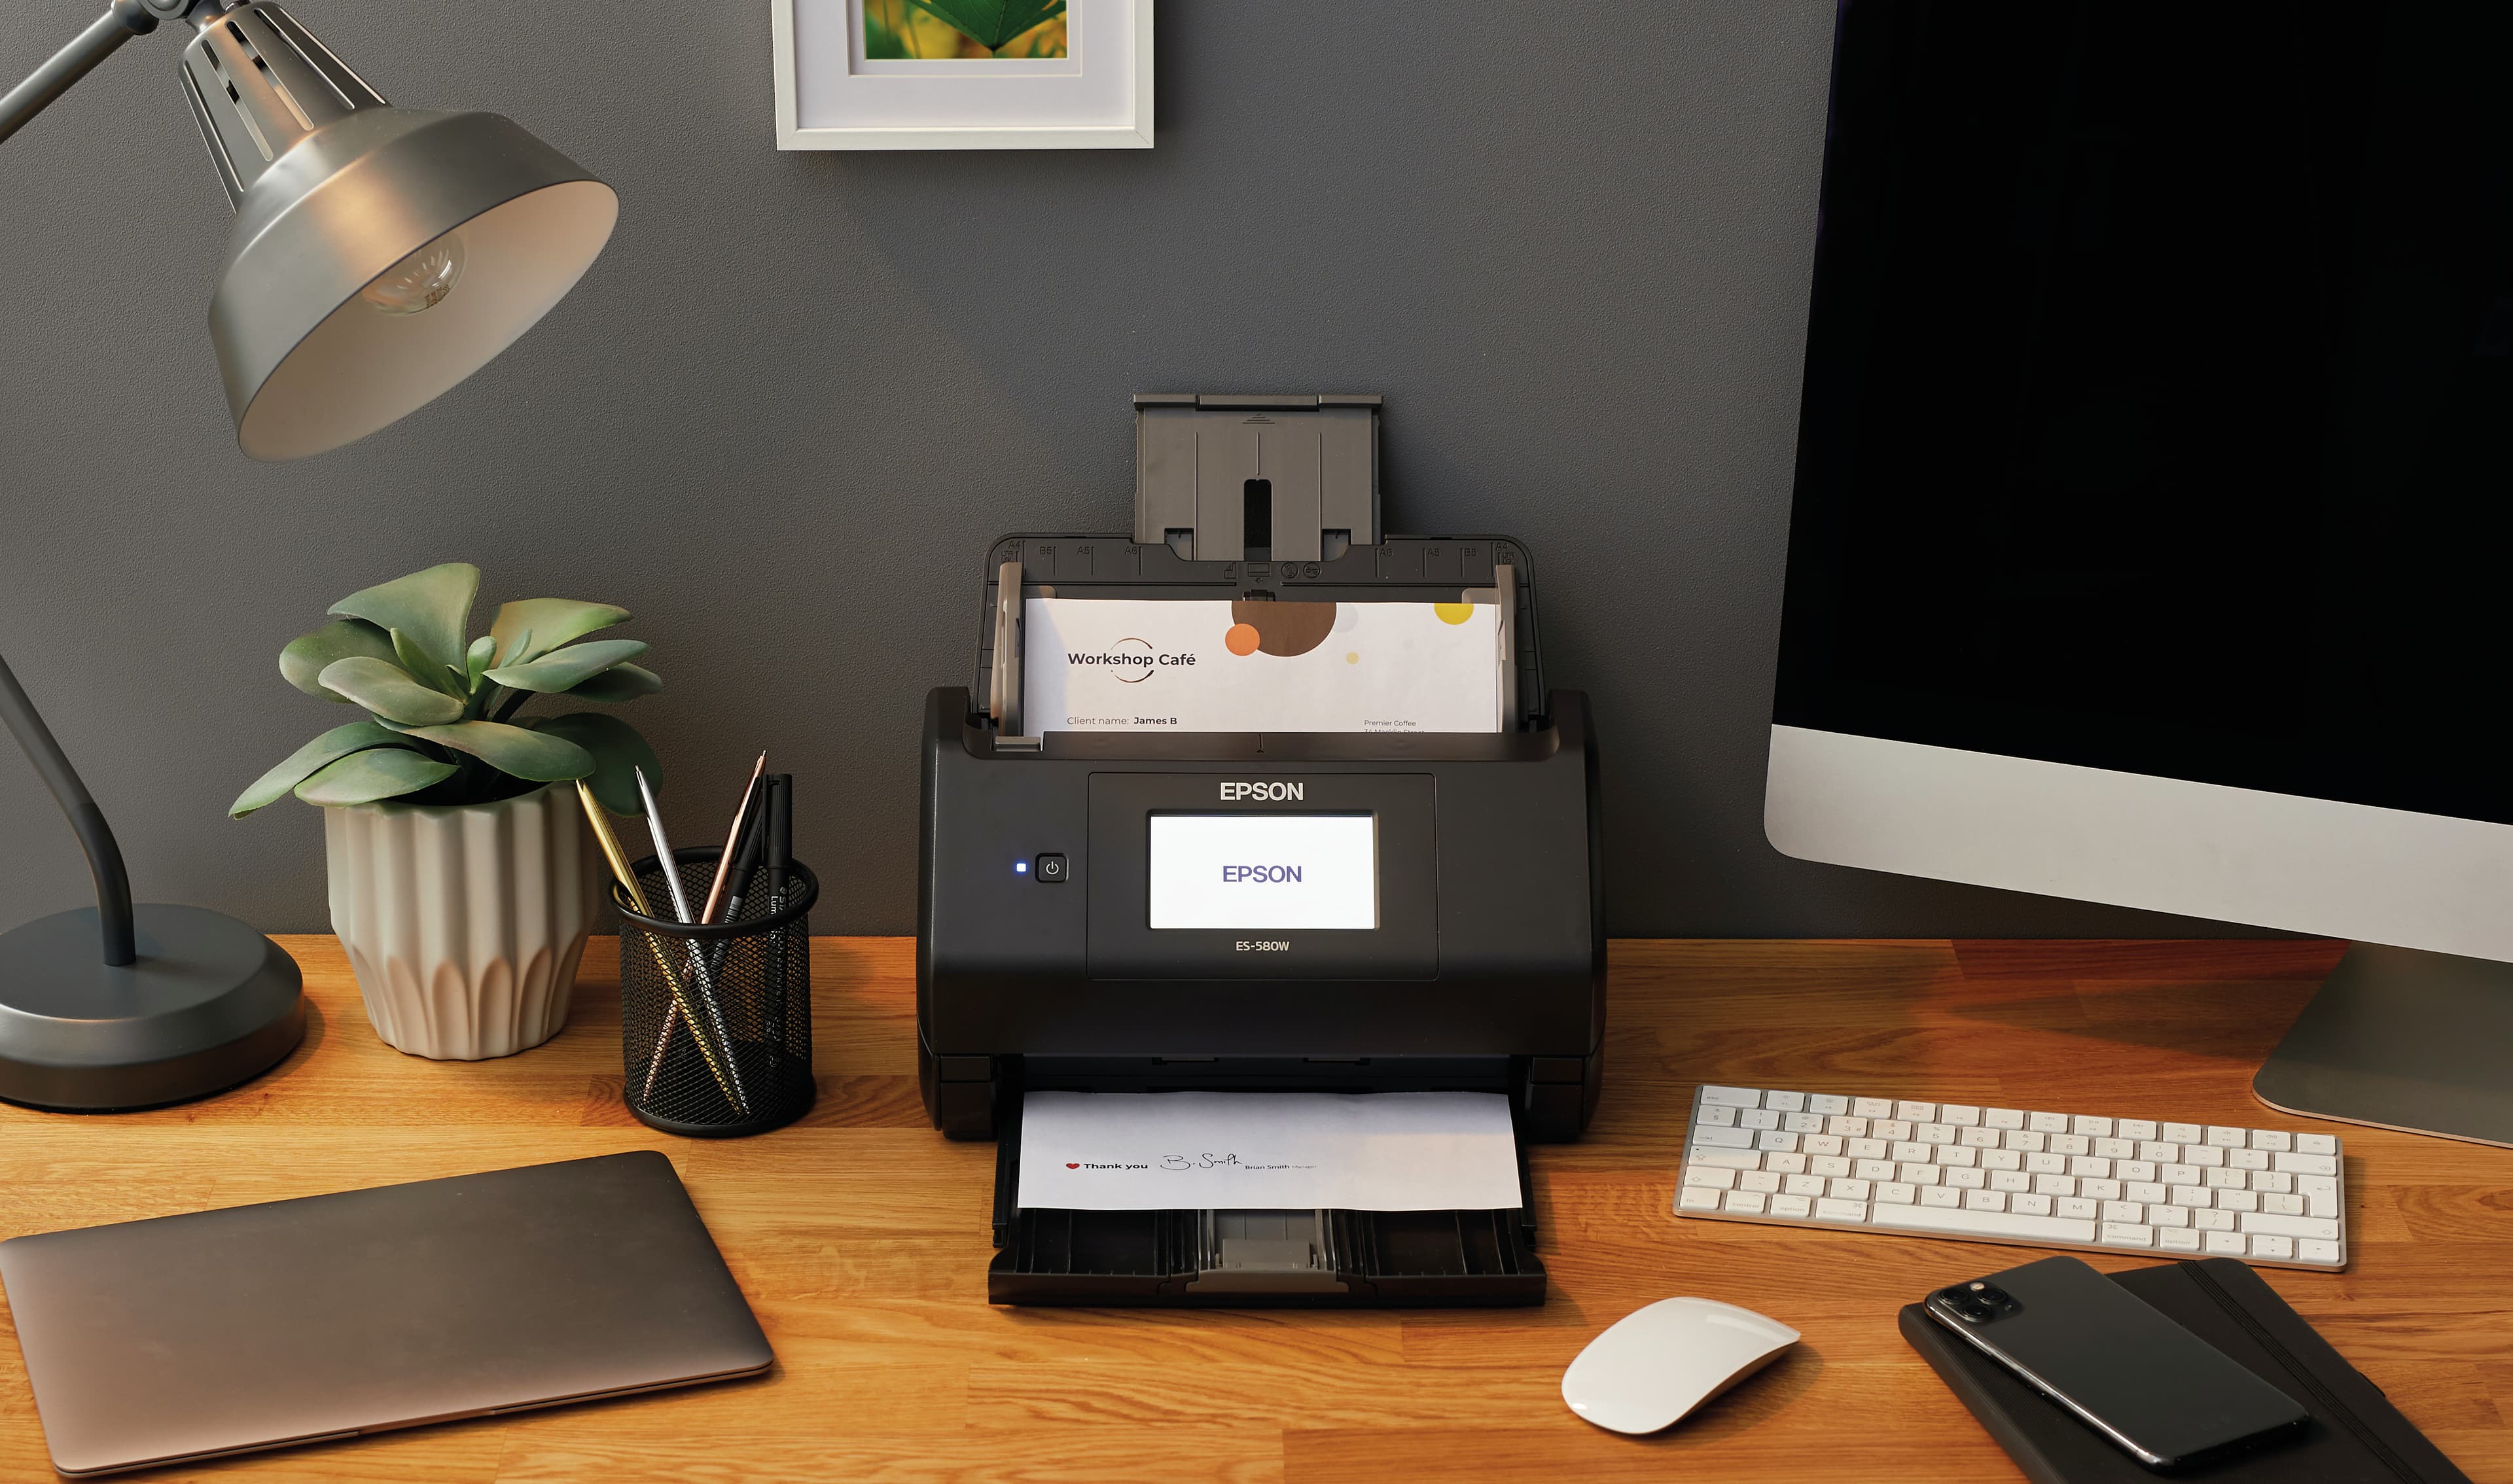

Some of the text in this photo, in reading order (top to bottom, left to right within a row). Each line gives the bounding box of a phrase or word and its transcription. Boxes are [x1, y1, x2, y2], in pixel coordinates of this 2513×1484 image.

[1008, 540, 1137, 555] A4 B5 A5 A6
[1068, 653, 1196, 667] Workshop Café
[1220, 782, 1304, 801] EPSON
[1222, 865, 1302, 883] EPSON
[1236, 941, 1290, 951] ES-580W
[1199, 1154, 1241, 1168] Smith
